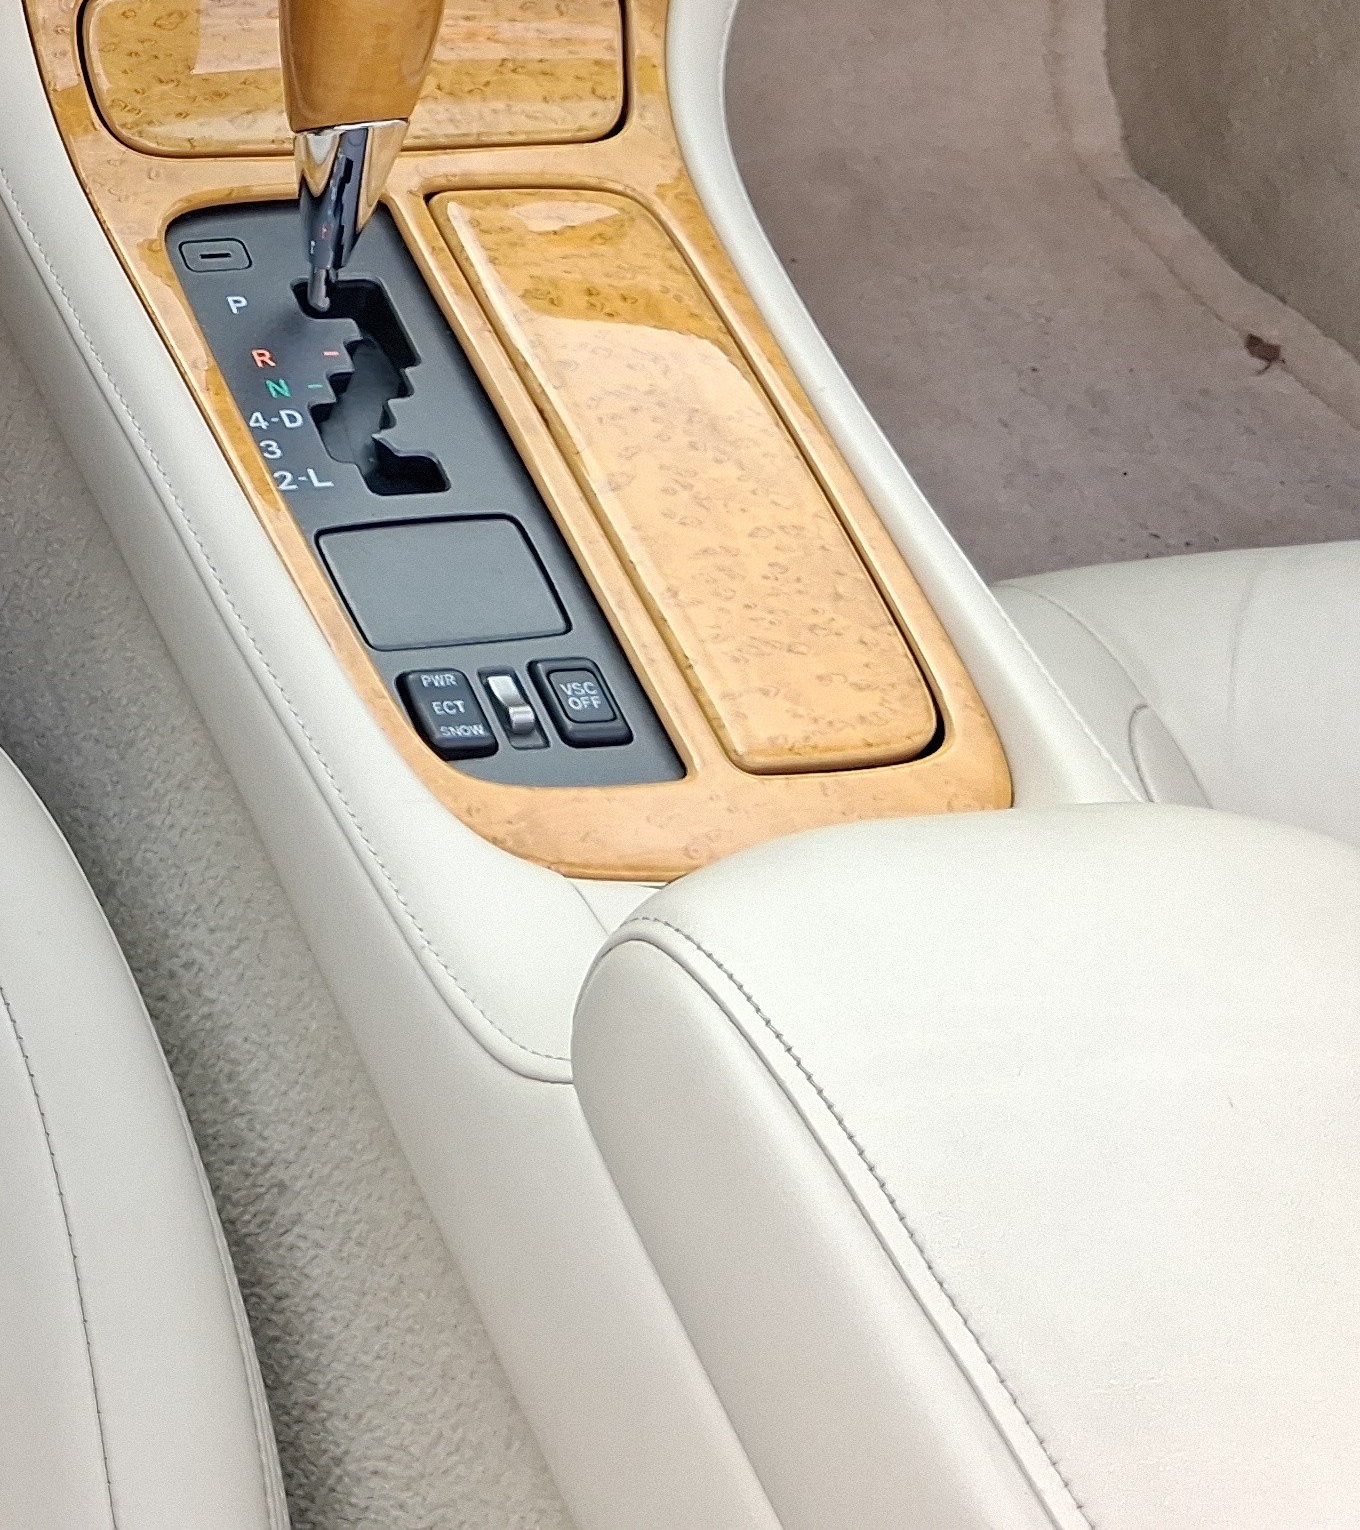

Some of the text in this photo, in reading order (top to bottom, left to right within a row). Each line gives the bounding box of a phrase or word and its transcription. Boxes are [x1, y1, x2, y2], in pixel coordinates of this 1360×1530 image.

[227, 296, 248, 314] P
[251, 349, 276, 368] R
[265, 378, 291, 398] N
[249, 410, 303, 430] 4-D
[259, 440, 282, 459] 3
[273, 468, 334, 490] 2-L
[421, 674, 457, 687] PWR
[559, 682, 597, 695] VSC
[432, 700, 464, 715] ECT
[568, 696, 601, 710] OFF
[440, 724, 485, 737] SNOW
